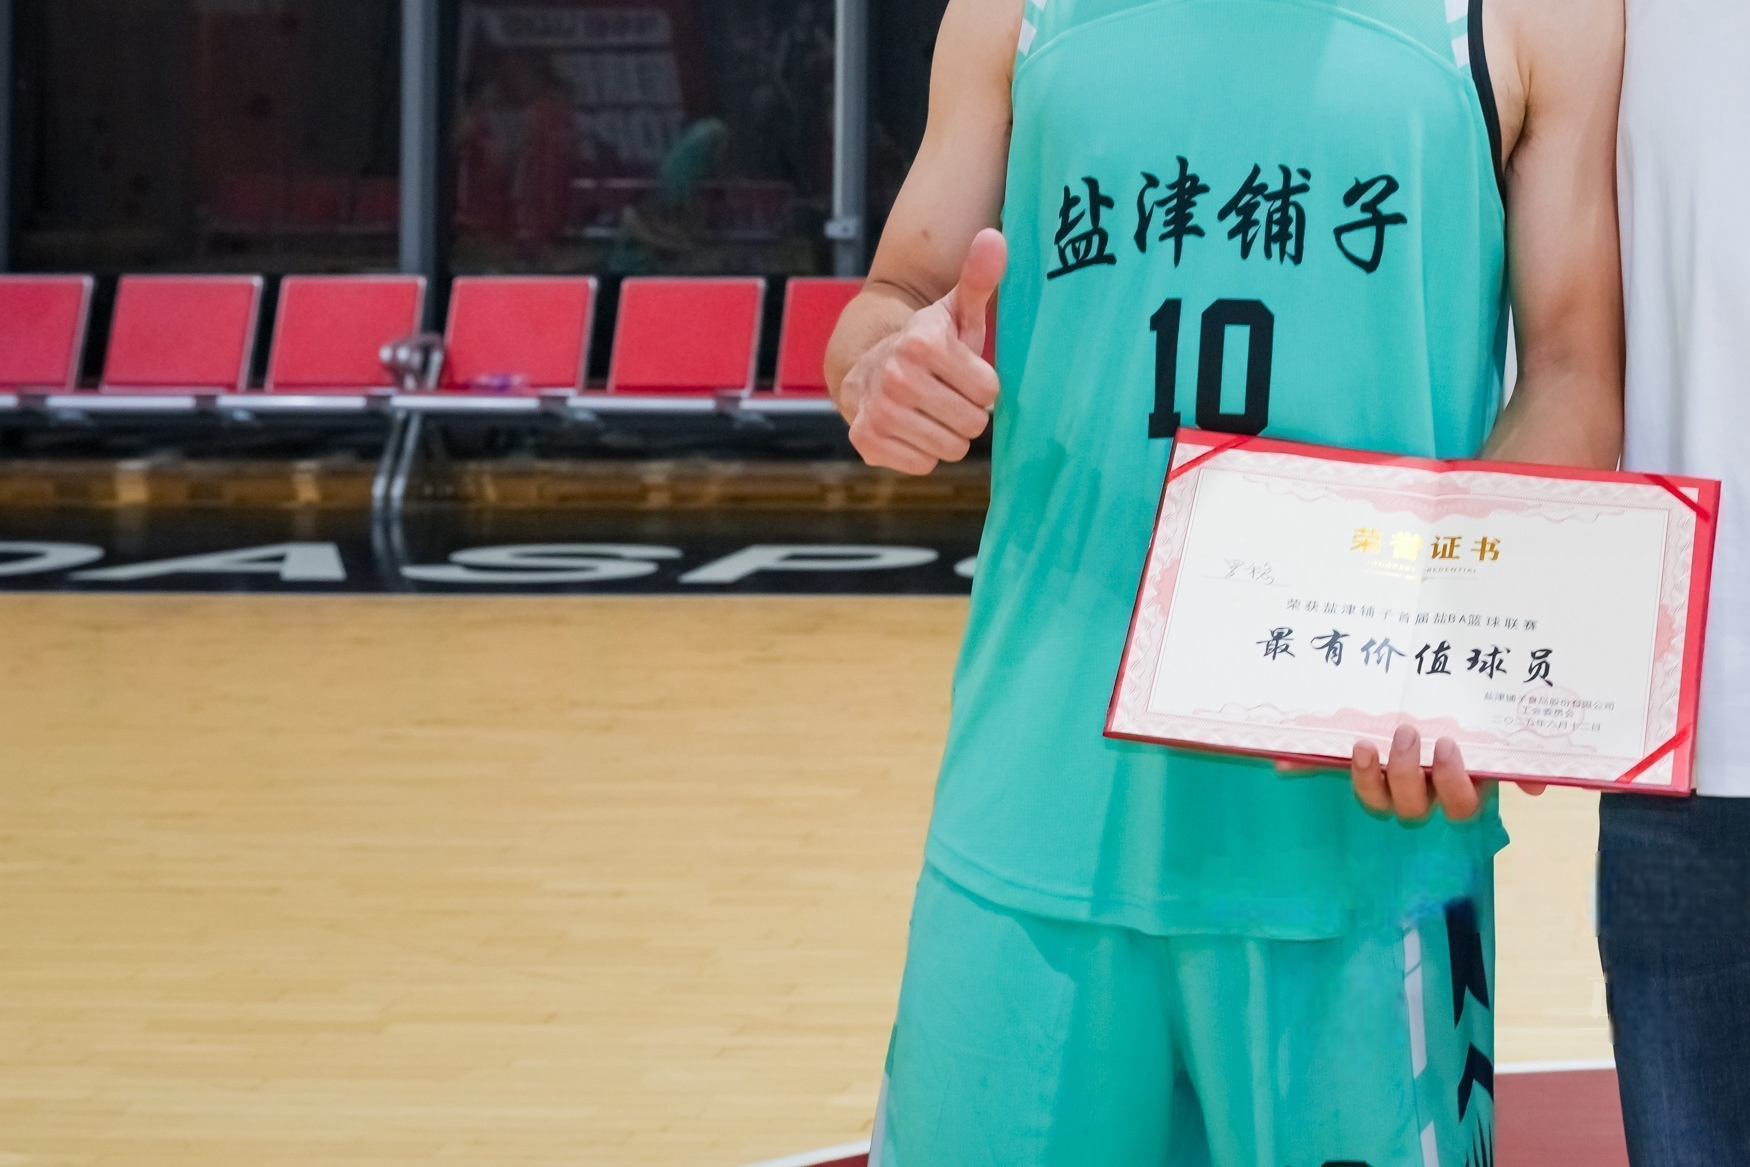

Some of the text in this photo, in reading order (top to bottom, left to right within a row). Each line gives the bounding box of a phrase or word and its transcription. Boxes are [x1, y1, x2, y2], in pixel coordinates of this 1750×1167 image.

[1046, 155, 1408, 280] 盐津铺子
[1148, 298, 1275, 439] 10
[1350, 526, 1502, 562] 荣誉证书
[1255, 627, 1554, 687] 最有价值球员
